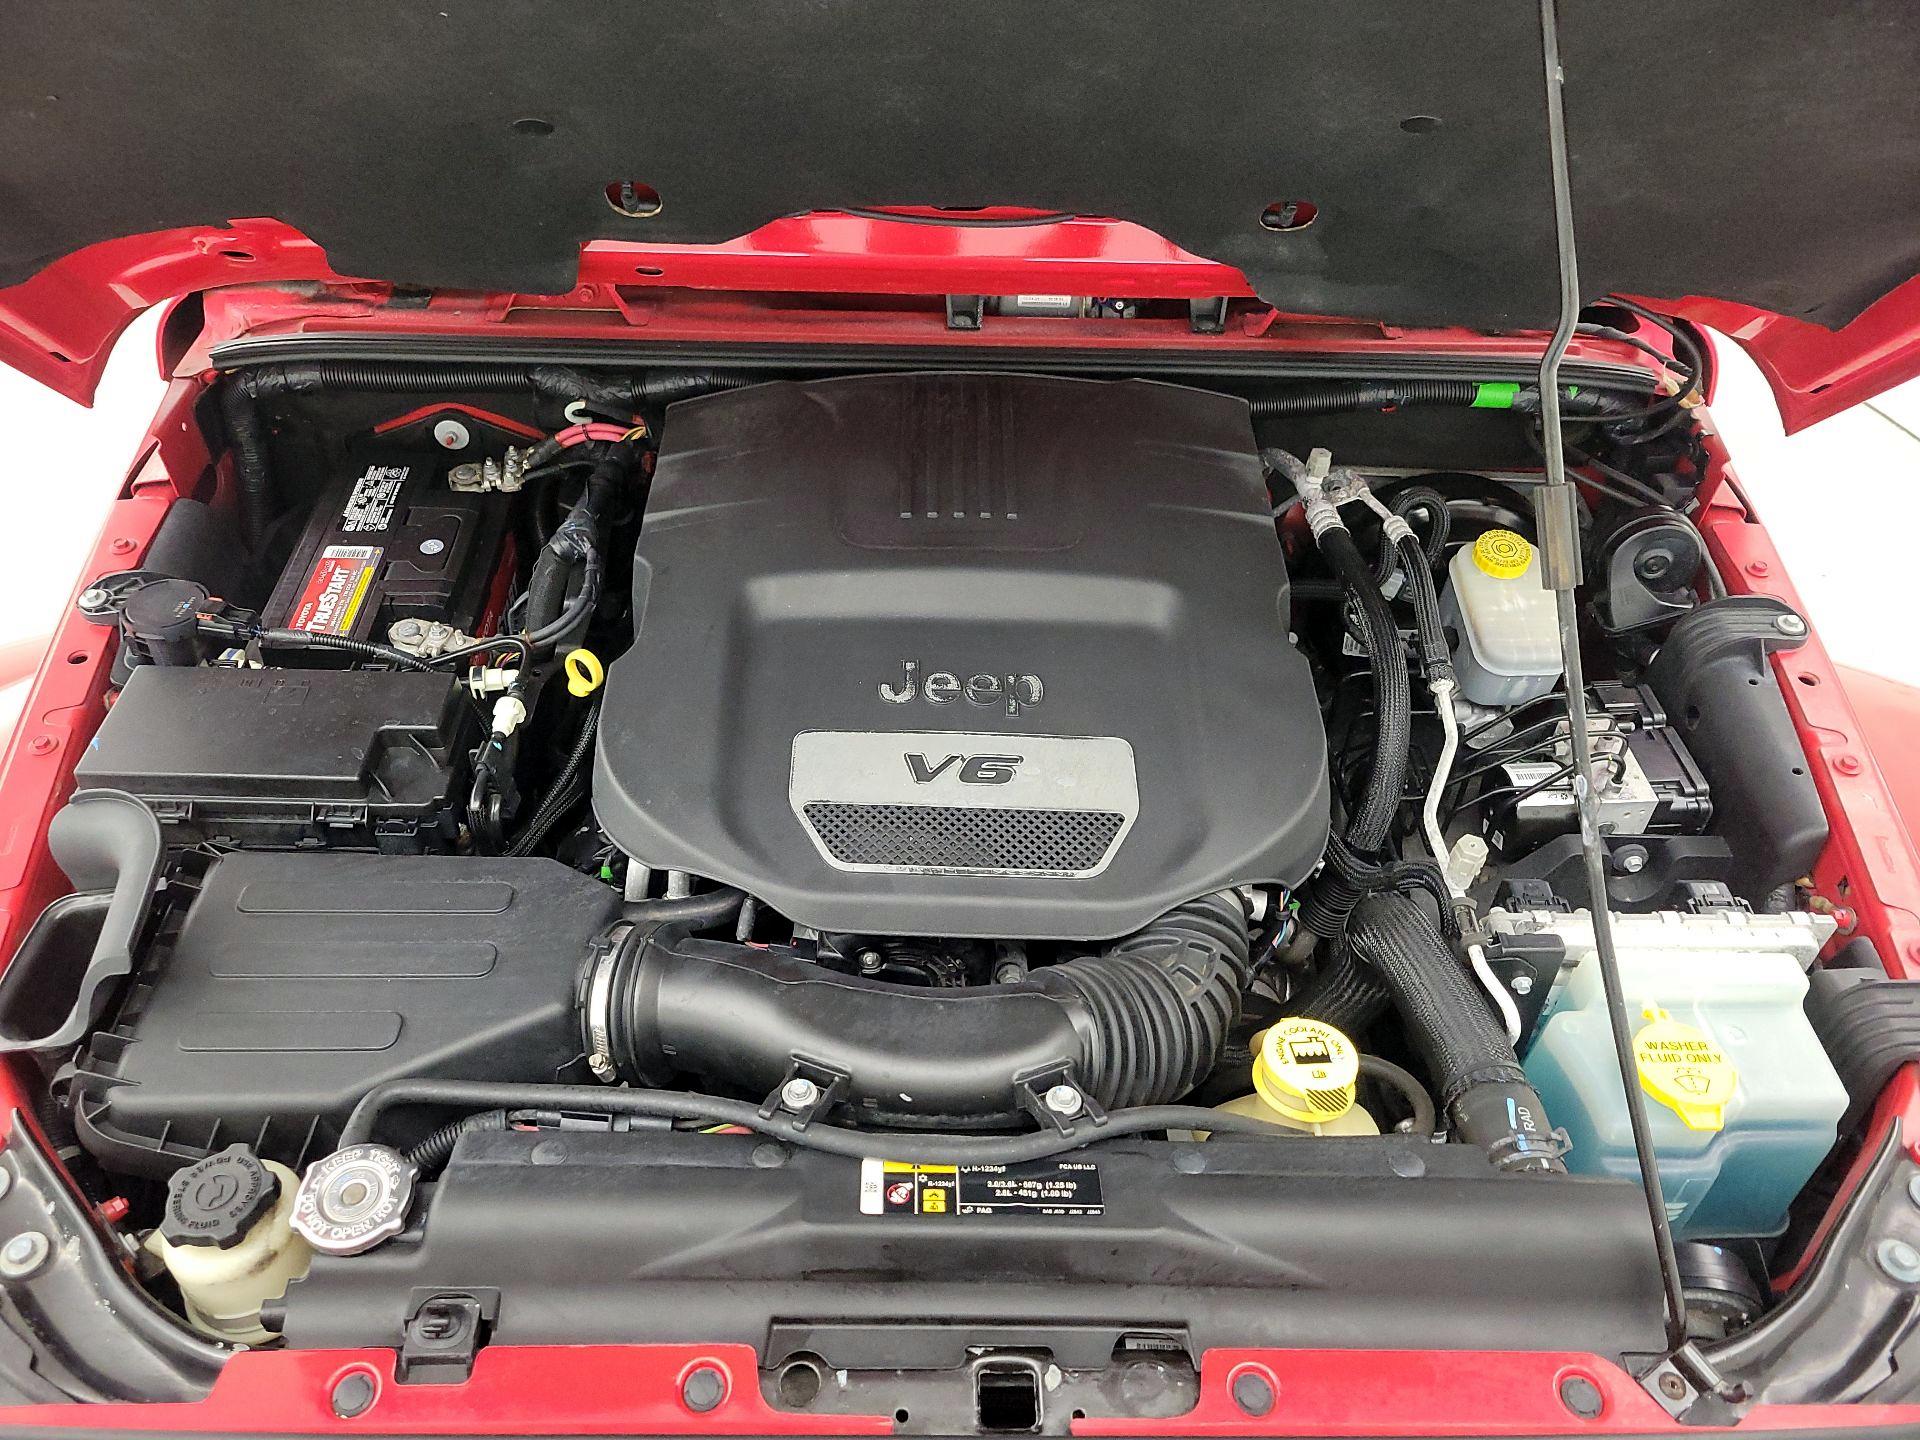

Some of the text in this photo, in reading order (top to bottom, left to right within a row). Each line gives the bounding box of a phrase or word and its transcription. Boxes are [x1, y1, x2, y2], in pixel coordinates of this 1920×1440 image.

[296, 602, 314, 628] TOYOTA
[878, 659, 1044, 718] Jeep
[903, 752, 1024, 785] V6
[1283, 1025, 1331, 1039] COOLANT
[1640, 1053, 1722, 1063] FLUID ONLY
[1644, 1041, 1709, 1051] WASHER
[1517, 1106, 1537, 1132] RAD
[321, 1149, 363, 1174] KEEP
[173, 1156, 231, 1230] POWER STEERING FLUID
[300, 1194, 399, 1239] DO NOT OPEN HOT
